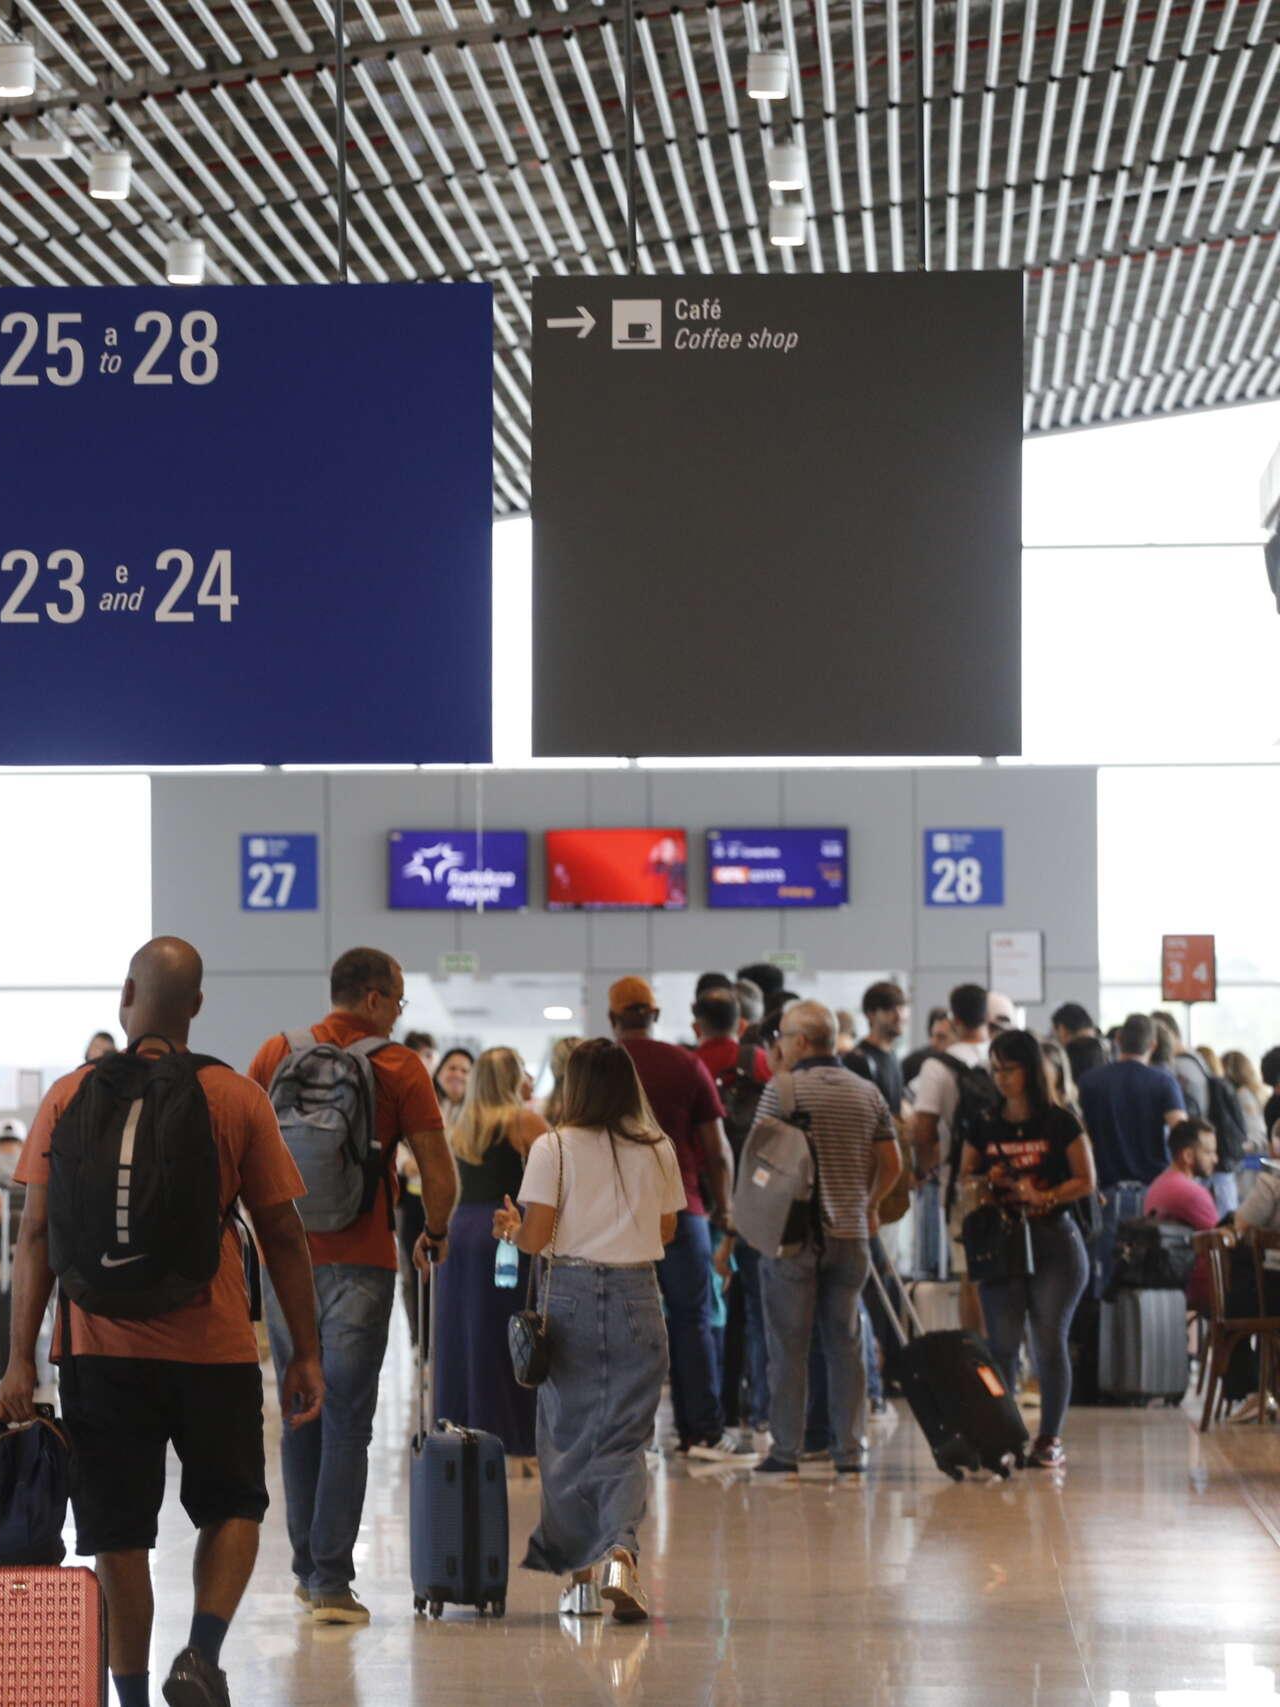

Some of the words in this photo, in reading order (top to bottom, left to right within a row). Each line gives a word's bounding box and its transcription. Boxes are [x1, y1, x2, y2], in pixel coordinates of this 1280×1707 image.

[674, 298, 722, 321] Café
[0, 312, 84, 386] 25
[104, 327, 118, 346] a
[133, 310, 219, 385] 28
[674, 328, 742, 350] Coffee
[747, 327, 799, 353] shop
[99, 351, 122, 374] to
[0, 549, 85, 624] 23
[115, 565, 129, 584] e
[154, 548, 239, 622] 24
[99, 587, 145, 611] and
[248, 863, 296, 907] 27
[932, 858, 982, 903] 28
[1167, 961, 1184, 983] 3
[1192, 960, 1209, 982] 4
